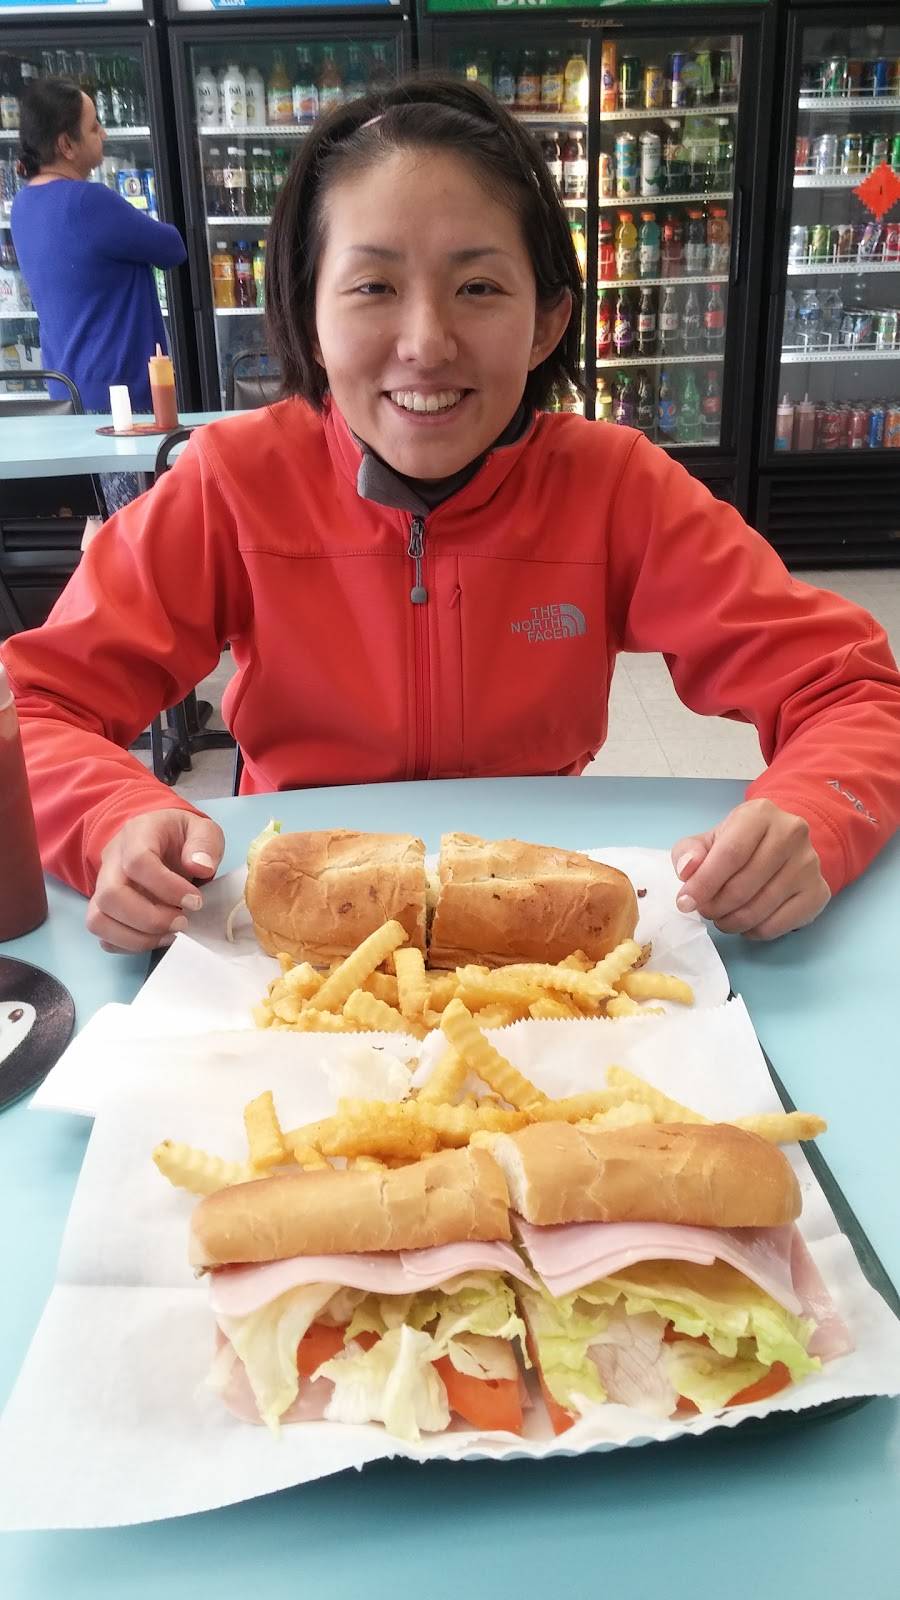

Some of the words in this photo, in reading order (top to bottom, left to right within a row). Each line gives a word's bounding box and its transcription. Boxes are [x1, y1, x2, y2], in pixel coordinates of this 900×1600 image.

[530, 604, 559, 619] THE
[511, 616, 561, 633] NORTH
[527, 628, 562, 643] FACE
